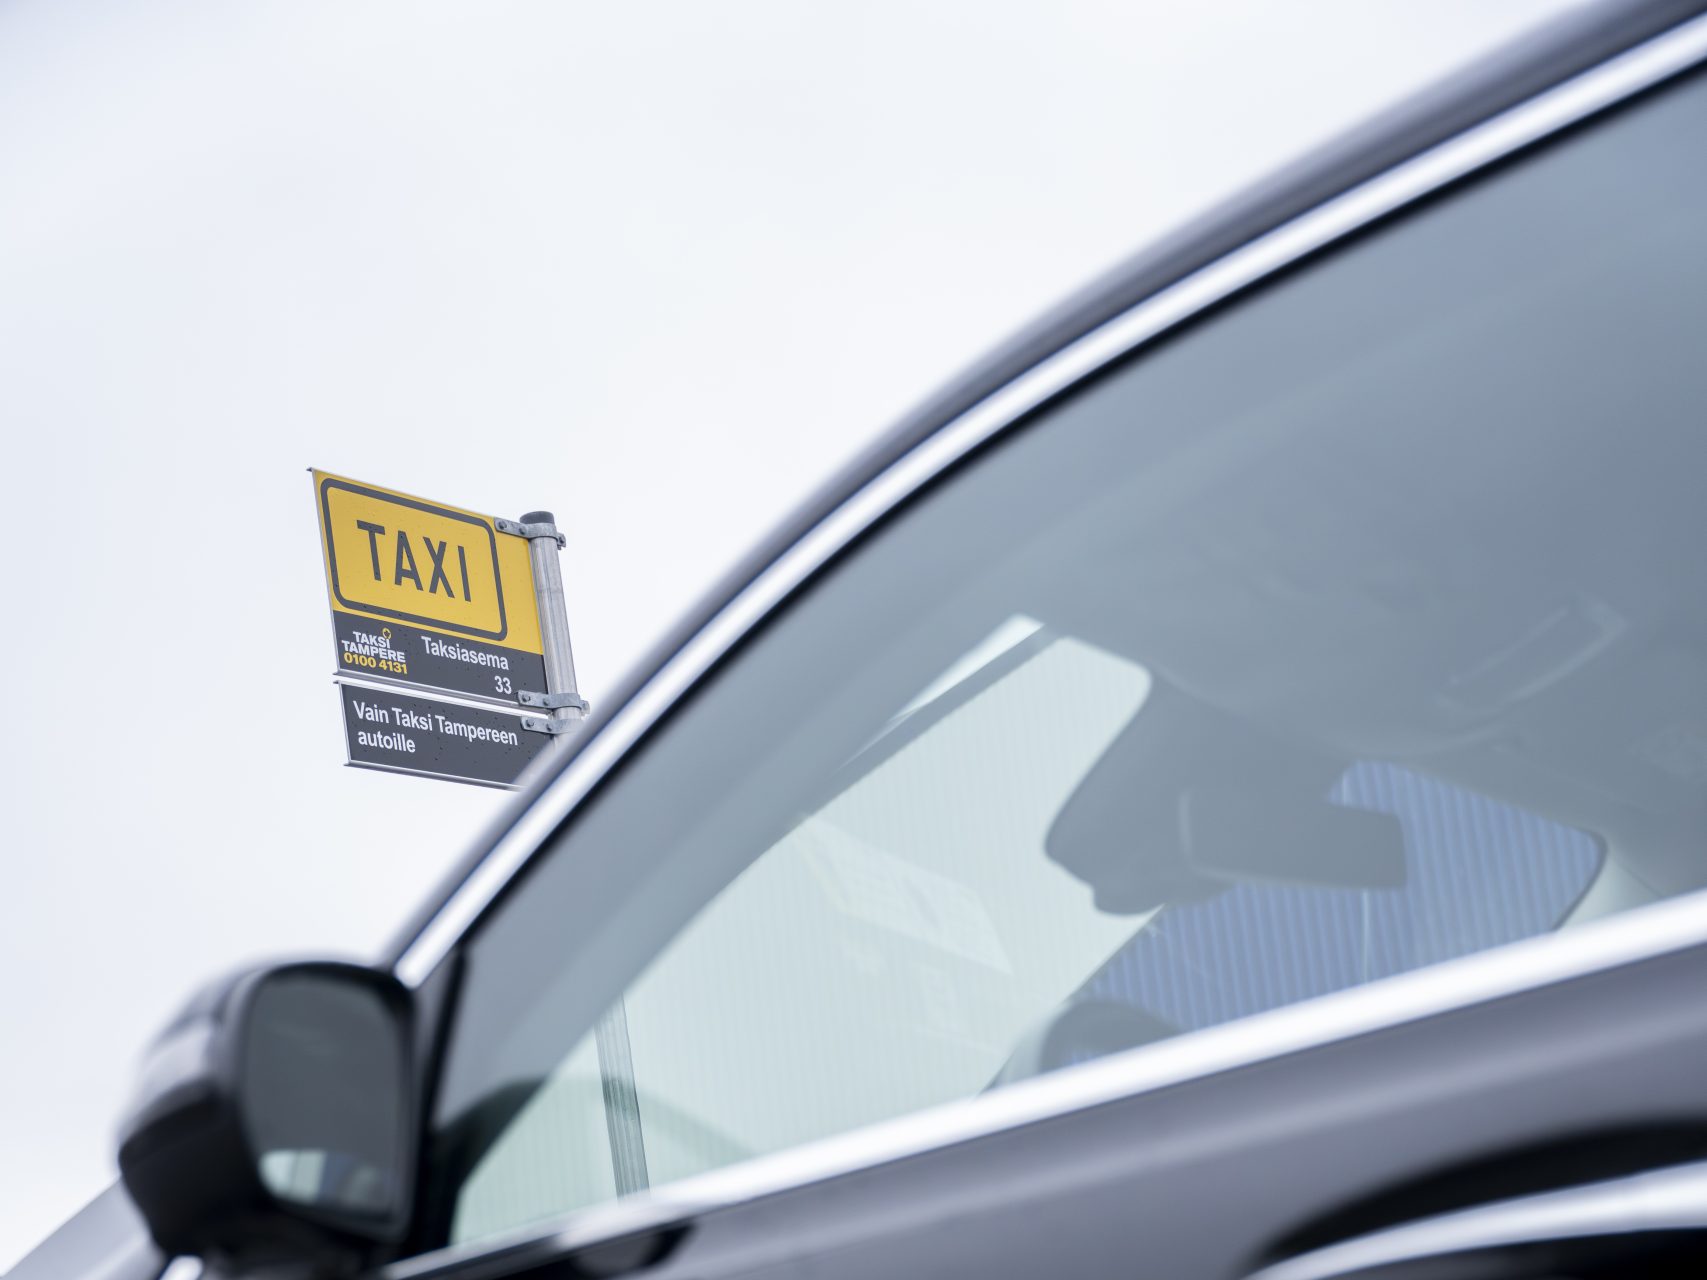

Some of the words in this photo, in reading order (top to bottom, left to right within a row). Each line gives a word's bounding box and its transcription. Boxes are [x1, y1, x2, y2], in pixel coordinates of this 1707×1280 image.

[356, 519, 472, 603] TAXI
[352, 630, 391, 648] TAKSI
[341, 640, 406, 664] TAMPERE
[343, 652, 377, 669] 0100
[379, 659, 408, 675] 4131
[421, 636, 509, 670] Taksiasema
[494, 675, 512, 695] 33
[353, 700, 389, 724] Vain
[392, 707, 433, 732] Taksi
[435, 714, 518, 746] Tampereen
[357, 729, 416, 753] autoille
